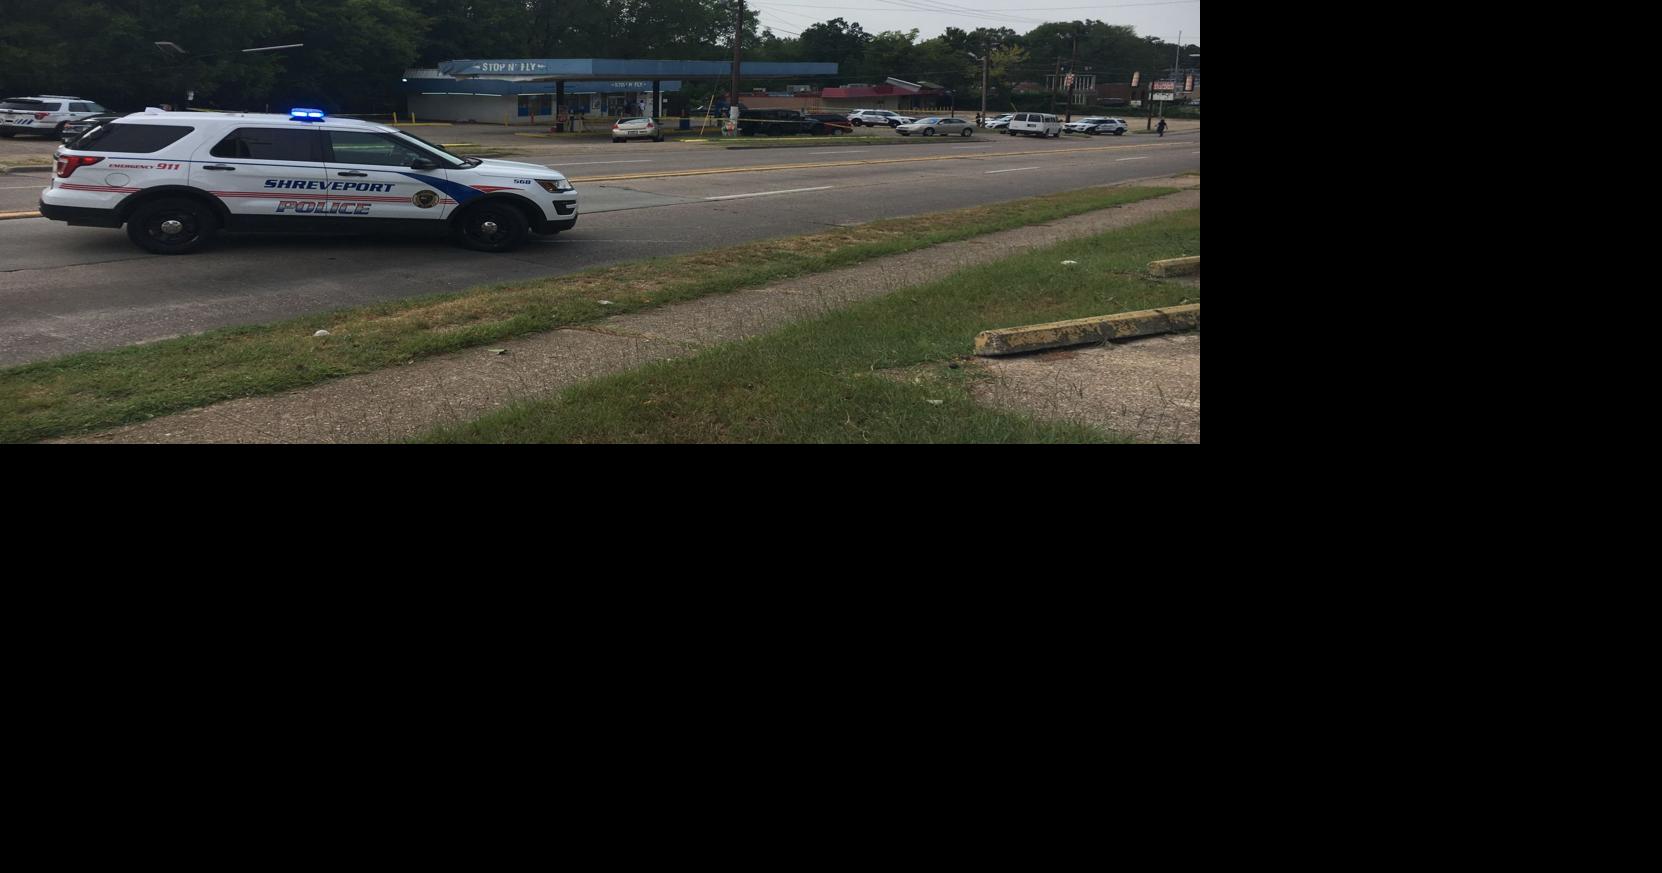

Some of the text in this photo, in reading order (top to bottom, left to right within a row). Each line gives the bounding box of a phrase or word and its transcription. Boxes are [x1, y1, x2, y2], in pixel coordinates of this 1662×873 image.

[482, 62, 505, 71] STOP
[521, 63, 535, 71] FLY
[264, 179, 395, 192] SHREVEPORT
[276, 200, 372, 215] POLICE
